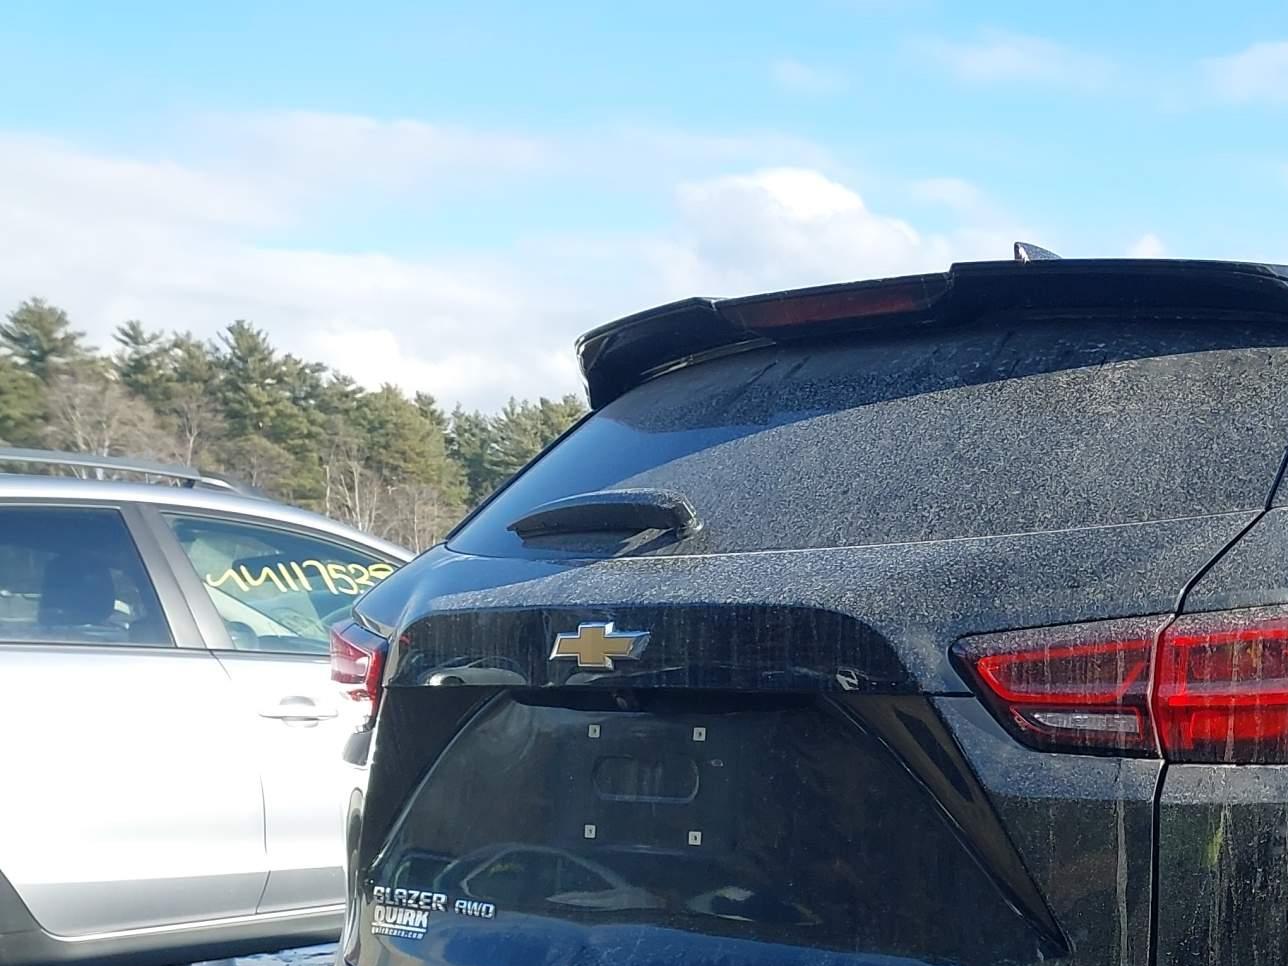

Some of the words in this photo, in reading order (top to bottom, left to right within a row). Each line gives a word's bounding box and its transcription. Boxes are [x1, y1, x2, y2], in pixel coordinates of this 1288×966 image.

[372, 886, 448, 912] BLAZER
[454, 899, 496, 920] AWD
[374, 905, 430, 928] QUIRK
[371, 926, 424, 940] quirkcars.com
